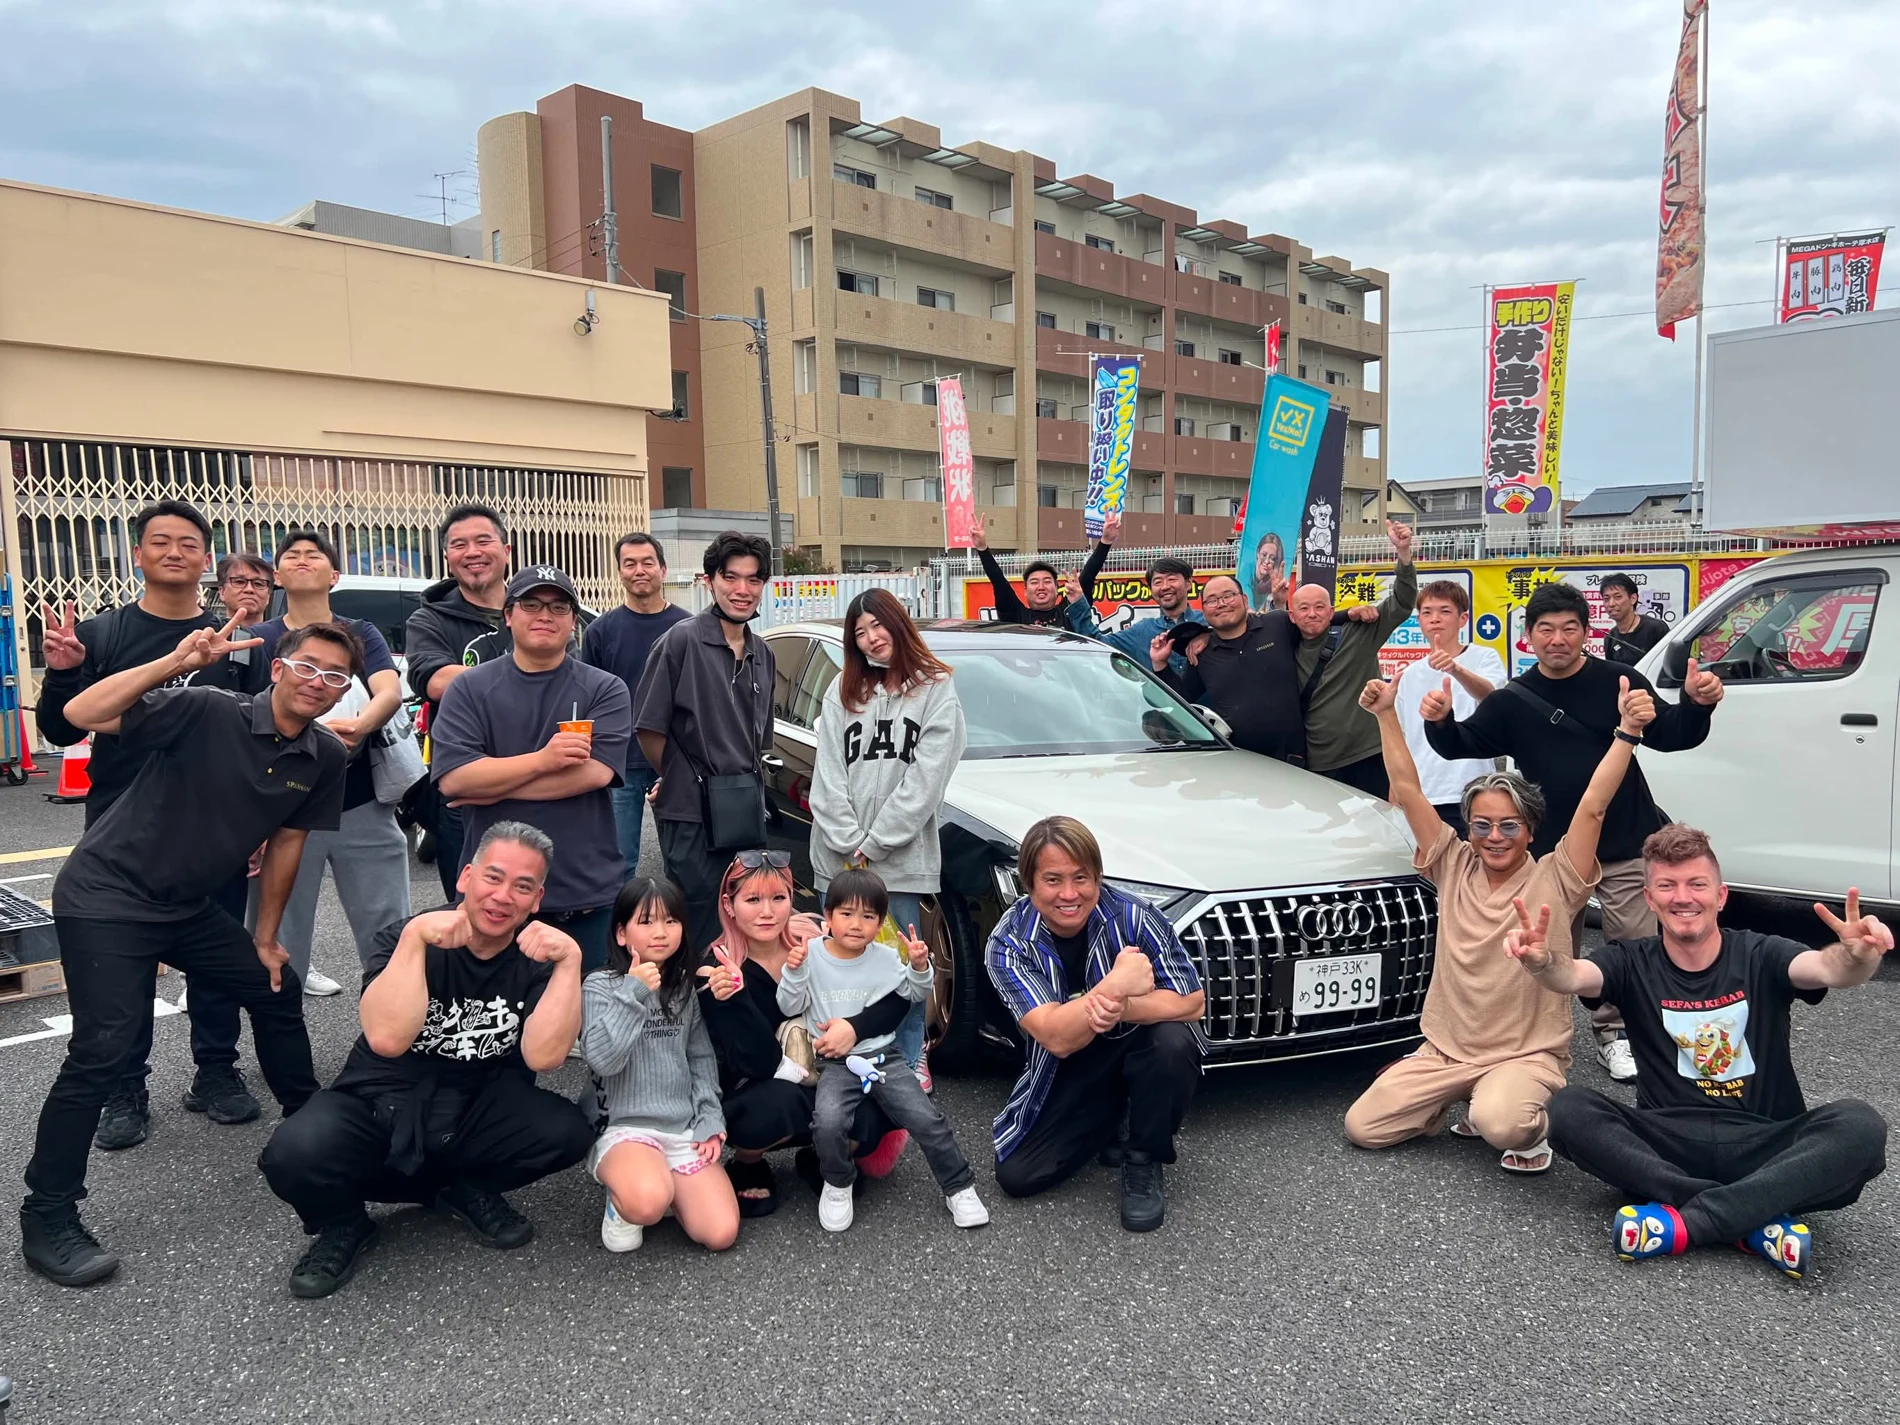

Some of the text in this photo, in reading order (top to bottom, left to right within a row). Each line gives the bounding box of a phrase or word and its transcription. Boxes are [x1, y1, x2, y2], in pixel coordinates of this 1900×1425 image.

[1494, 297, 1554, 328] 手作り
[1487, 328, 1545, 478] 弁当・惣菜
[1101, 366, 1138, 512] コンタクトレンズ
[1269, 439, 1308, 457] Car wash
[536, 567, 557, 581] NY
[1316, 960, 1363, 977] 神戸 33K
[1299, 976, 1376, 1009] め 99-99
[1661, 990, 1746, 1009] SEFA'S KEBAB
[651, 1029, 673, 1039] THING
[1696, 1080, 1712, 1089] NO
[1705, 1089, 1721, 1097] NO
